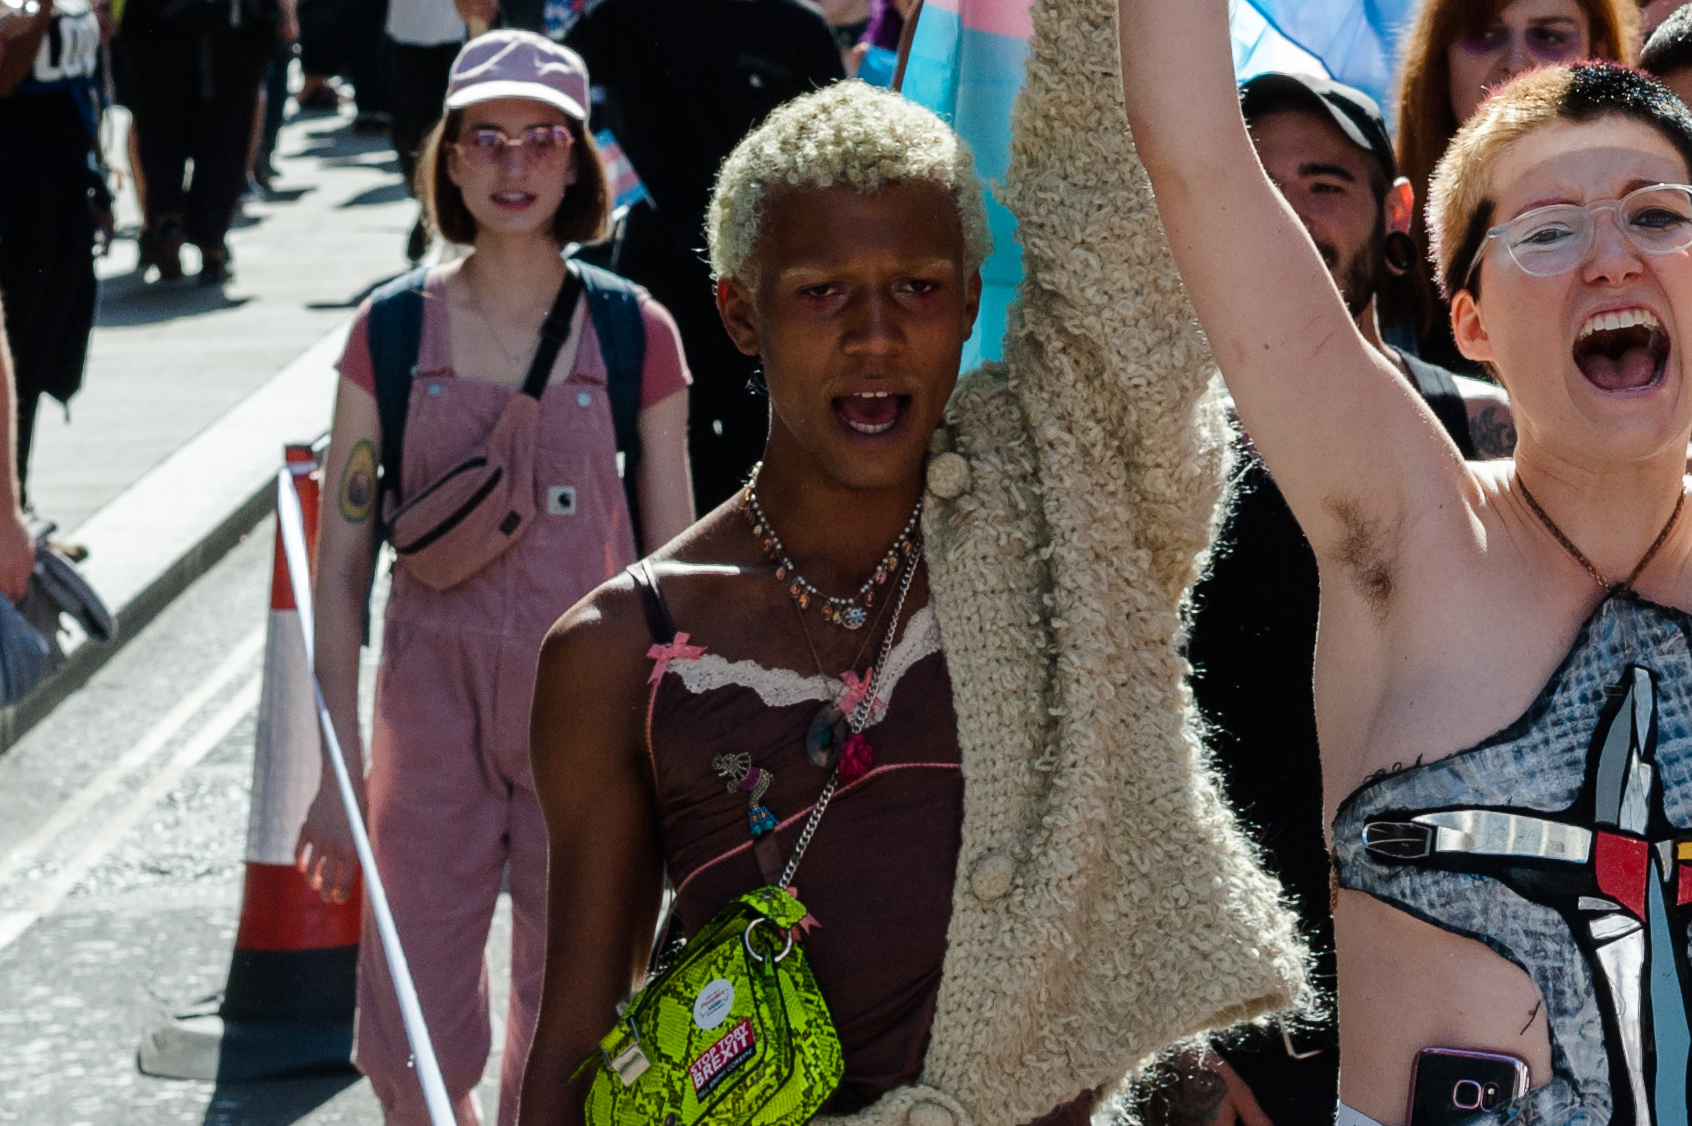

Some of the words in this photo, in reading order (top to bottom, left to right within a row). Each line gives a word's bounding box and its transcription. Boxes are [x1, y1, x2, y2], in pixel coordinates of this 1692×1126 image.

[690, 1045, 716, 1075] STOP
[718, 1022, 748, 1048] TORY
[693, 1031, 749, 1090] BREXIT
